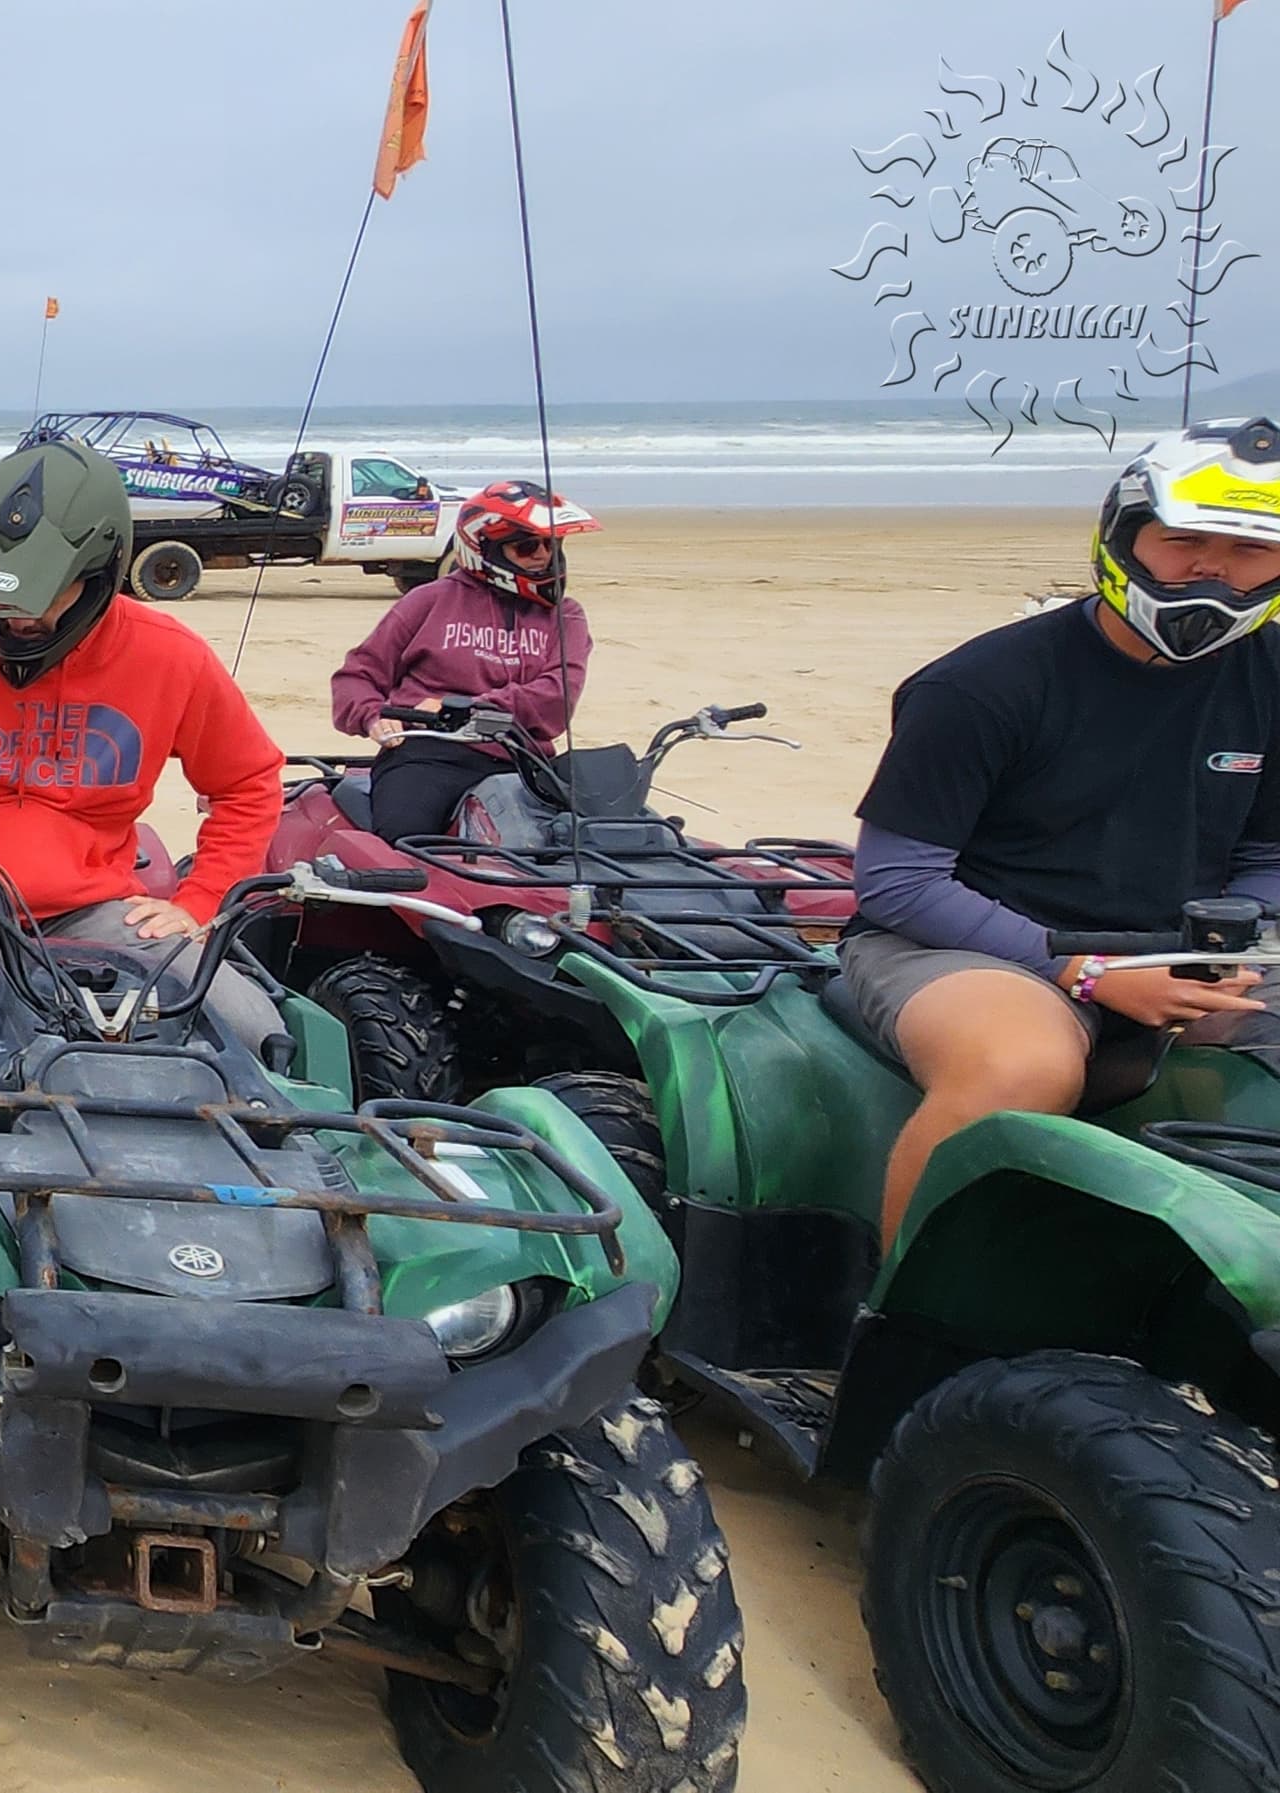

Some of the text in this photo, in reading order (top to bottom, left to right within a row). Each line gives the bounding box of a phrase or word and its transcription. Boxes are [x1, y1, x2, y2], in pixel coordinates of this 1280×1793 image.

[126, 467, 220, 493] SUNBUGGY
[442, 622, 494, 651] PISMO
[15, 702, 84, 730] THE
